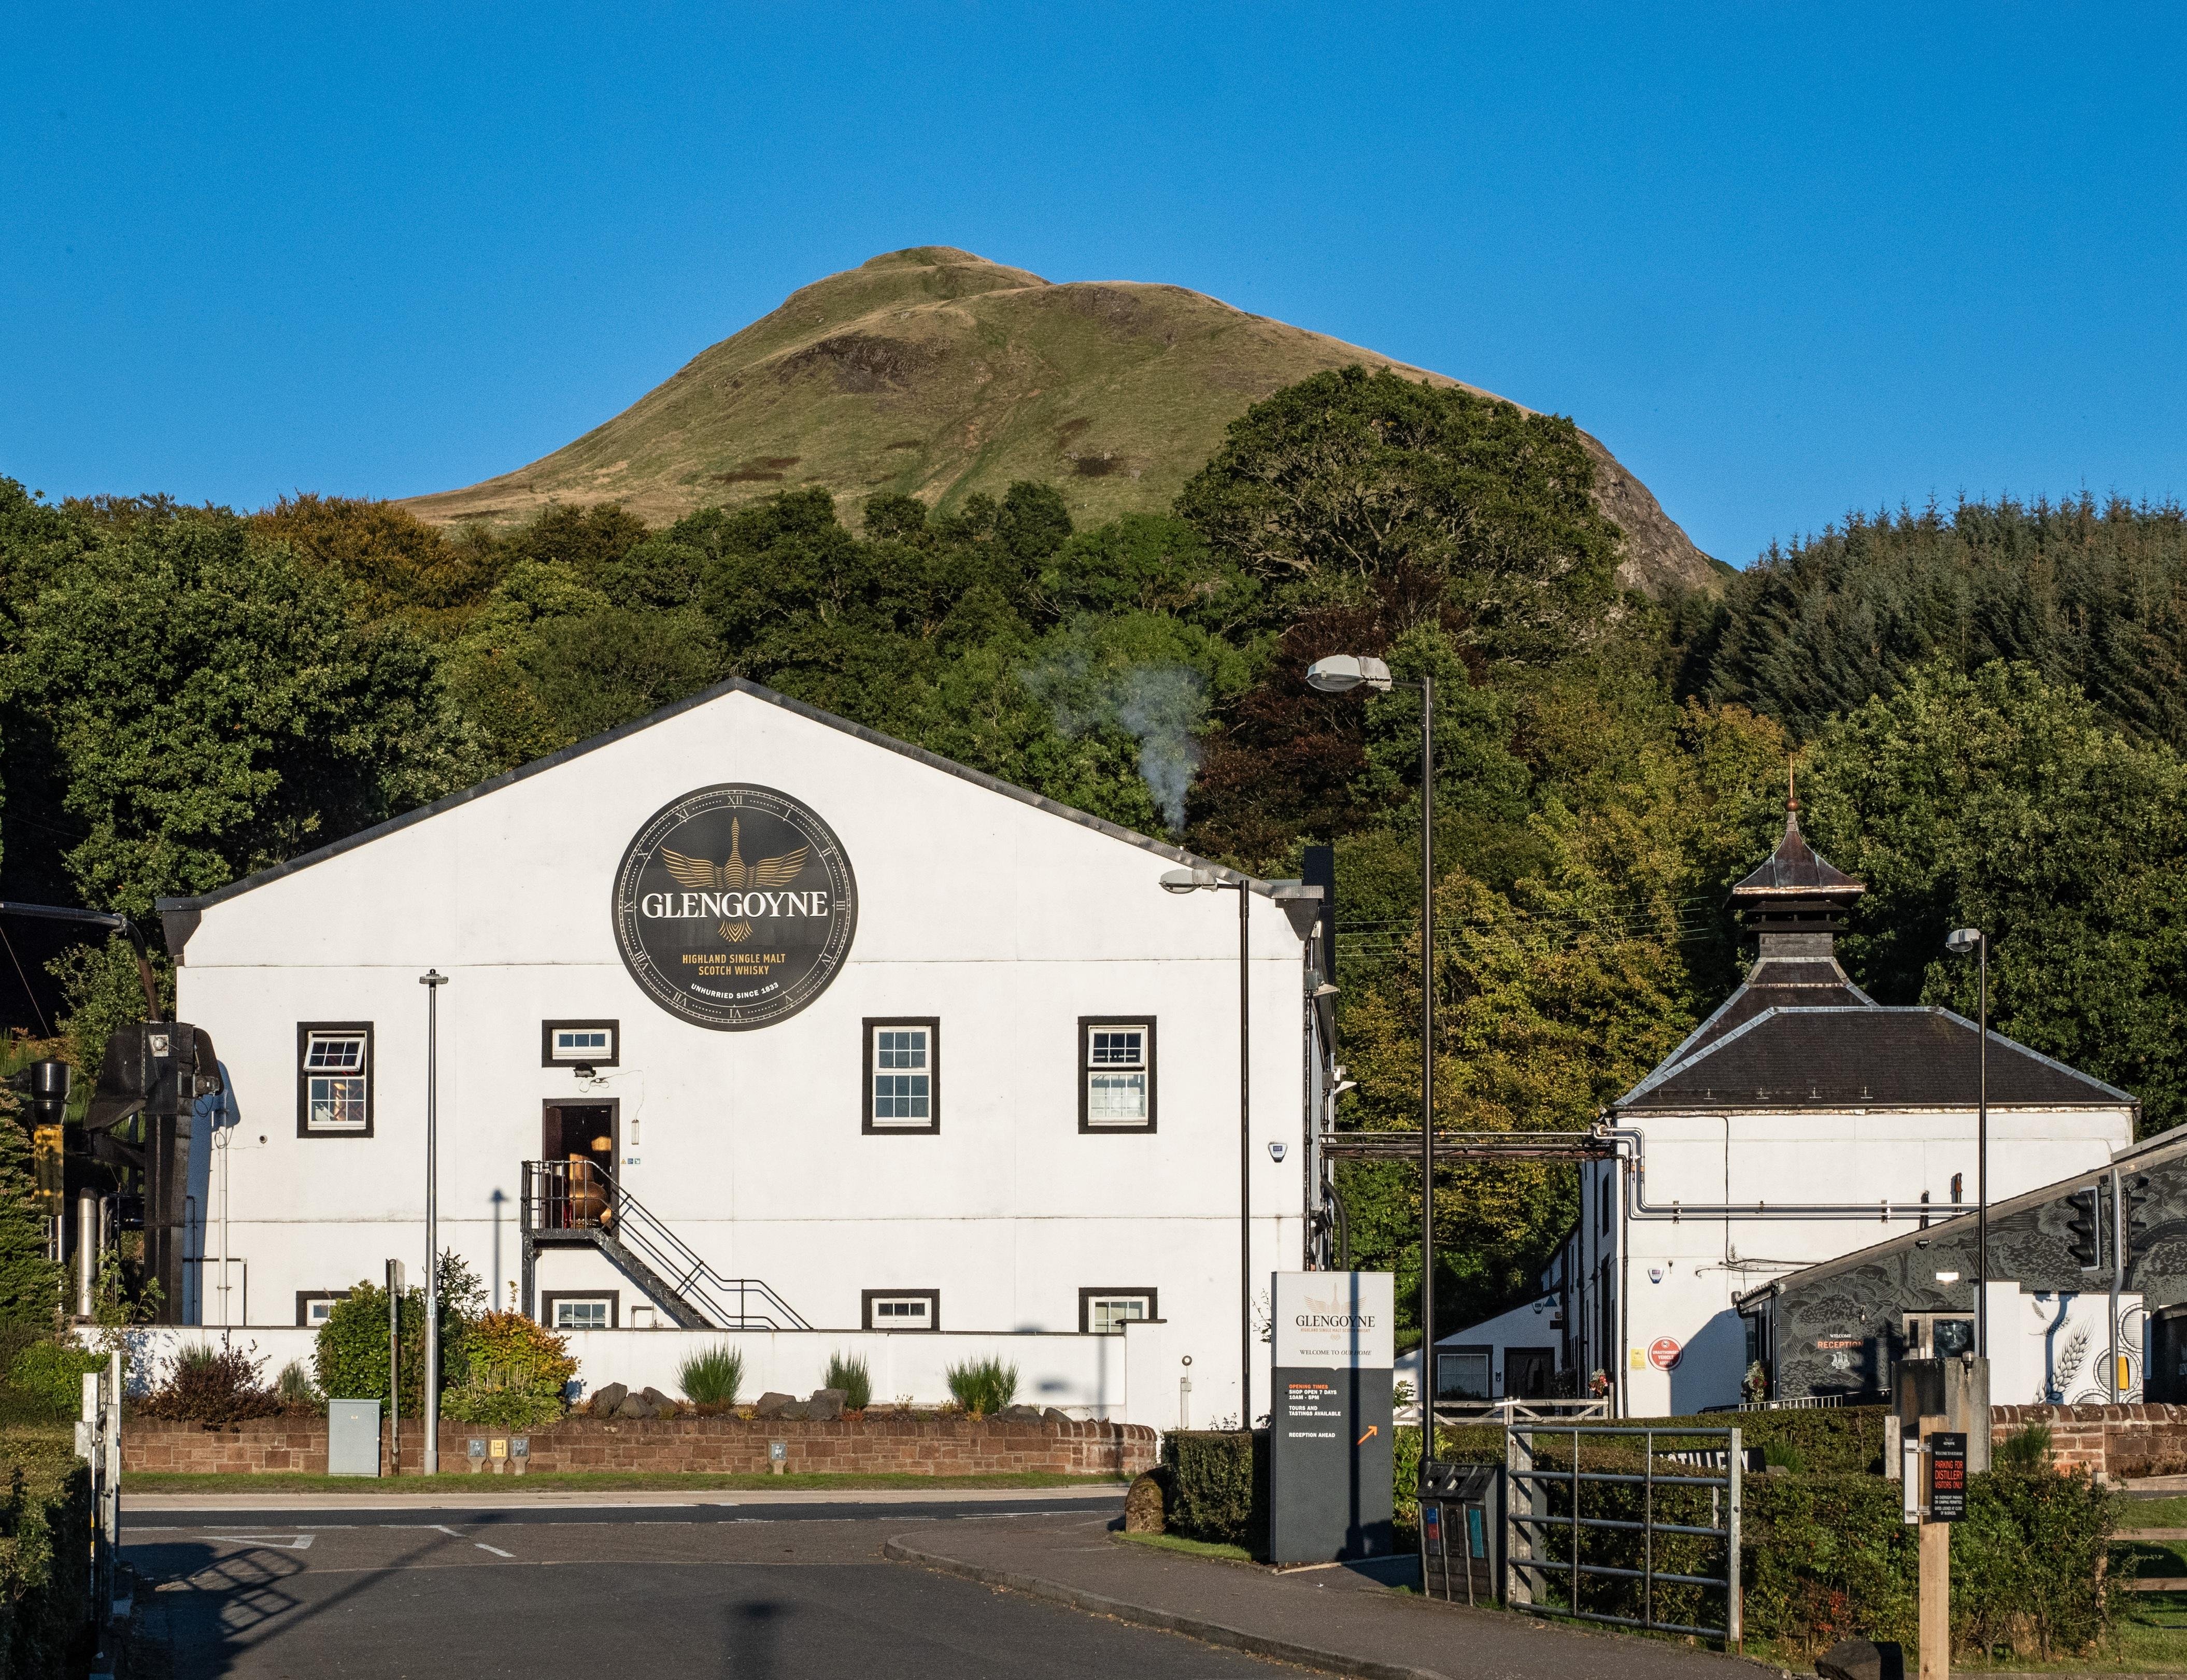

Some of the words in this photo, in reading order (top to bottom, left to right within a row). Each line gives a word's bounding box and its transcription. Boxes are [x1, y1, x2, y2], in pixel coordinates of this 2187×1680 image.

[727, 795, 743, 805] XII
[676, 809, 689, 821] XI
[637, 849, 648, 859] X
[821, 848, 832, 857] II
[642, 891, 829, 919] GLENGOYNE
[836, 900, 845, 910] III
[683, 954, 727, 964] HIGHLAND
[730, 954, 760, 963] SINGLE
[763, 953, 786, 963] MALT
[699, 966, 731, 975] SCOTCH
[735, 965, 770, 975] WHISKY
[691, 983, 734, 999] UNHURRIED
[736, 989, 759, 999] SINCE
[761, 981, 779, 994] 1833
[1296, 1315, 1375, 1328] GLENGOYNE
[1935, 1460, 1953, 1469] PARKING
[1954, 1460, 1963, 1469] FOR
[1935, 1470, 1963, 1480] DISTILLERY
